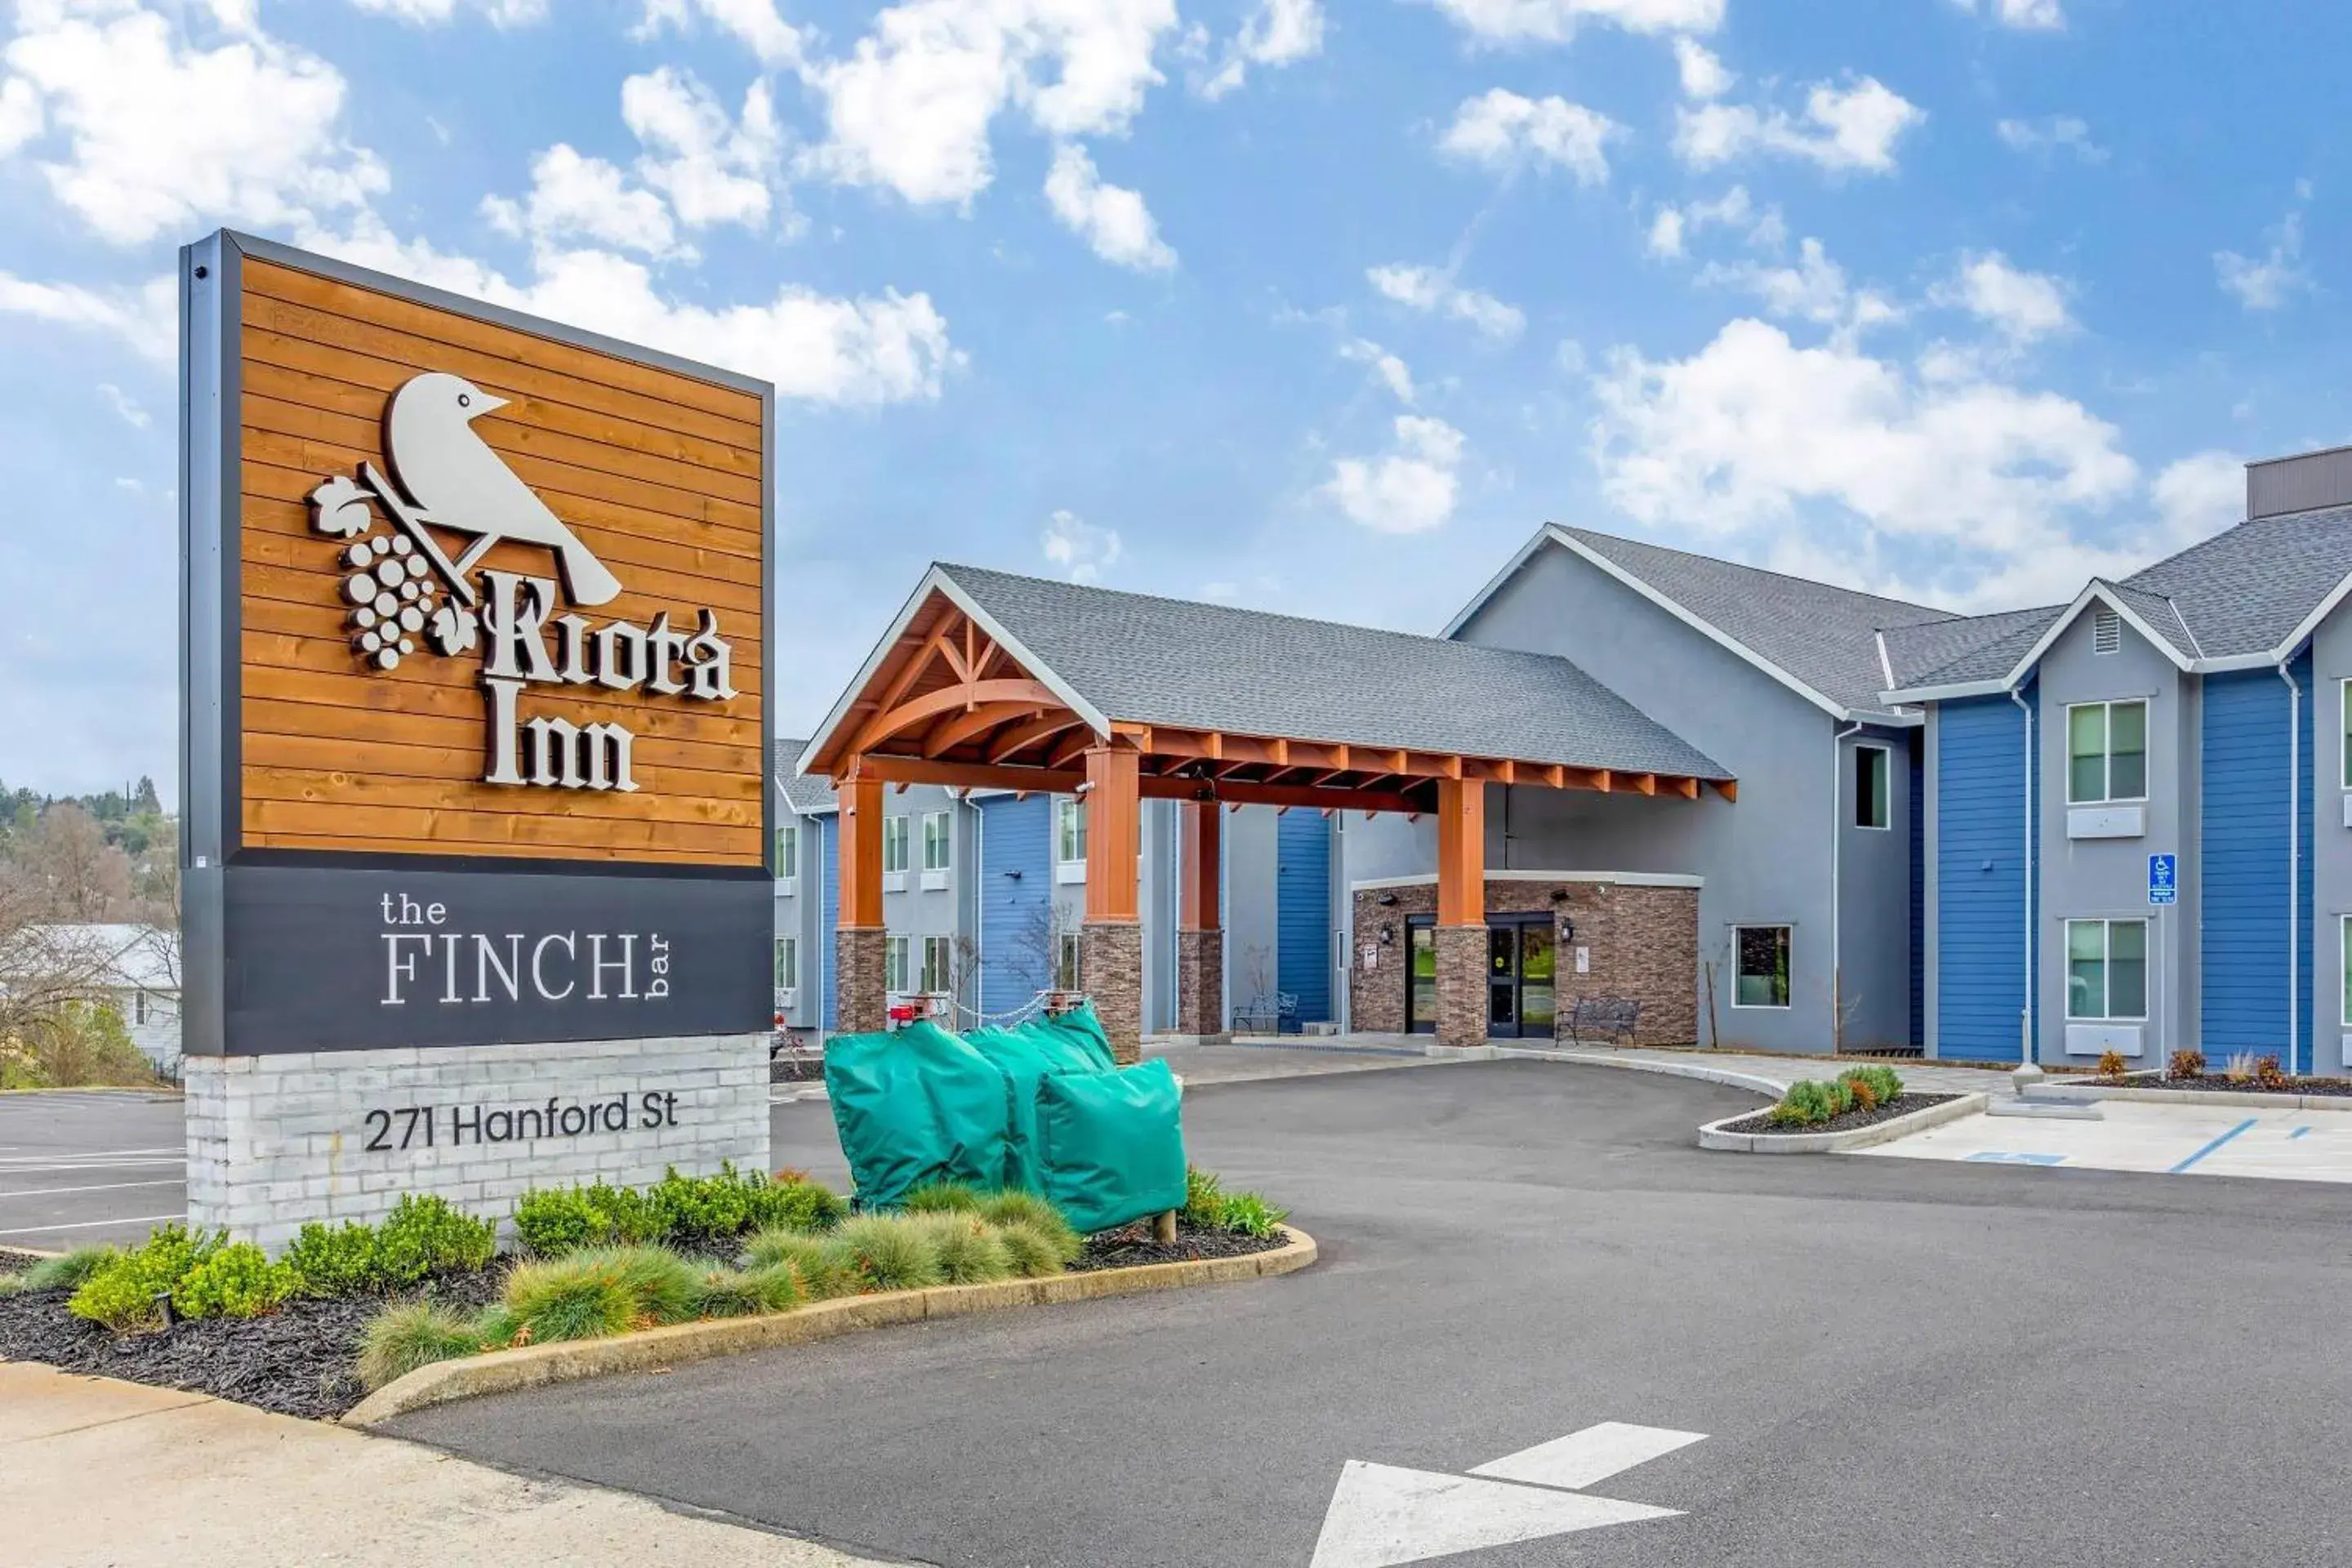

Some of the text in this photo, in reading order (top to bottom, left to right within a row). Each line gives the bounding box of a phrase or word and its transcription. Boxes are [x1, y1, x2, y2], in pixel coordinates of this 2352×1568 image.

[485, 677, 641, 792] Inn
[380, 892, 447, 925] the
[380, 929, 639, 1004] FINCH
[644, 933, 670, 1001] bar
[364, 1091, 679, 1152] 271 Hanford St
